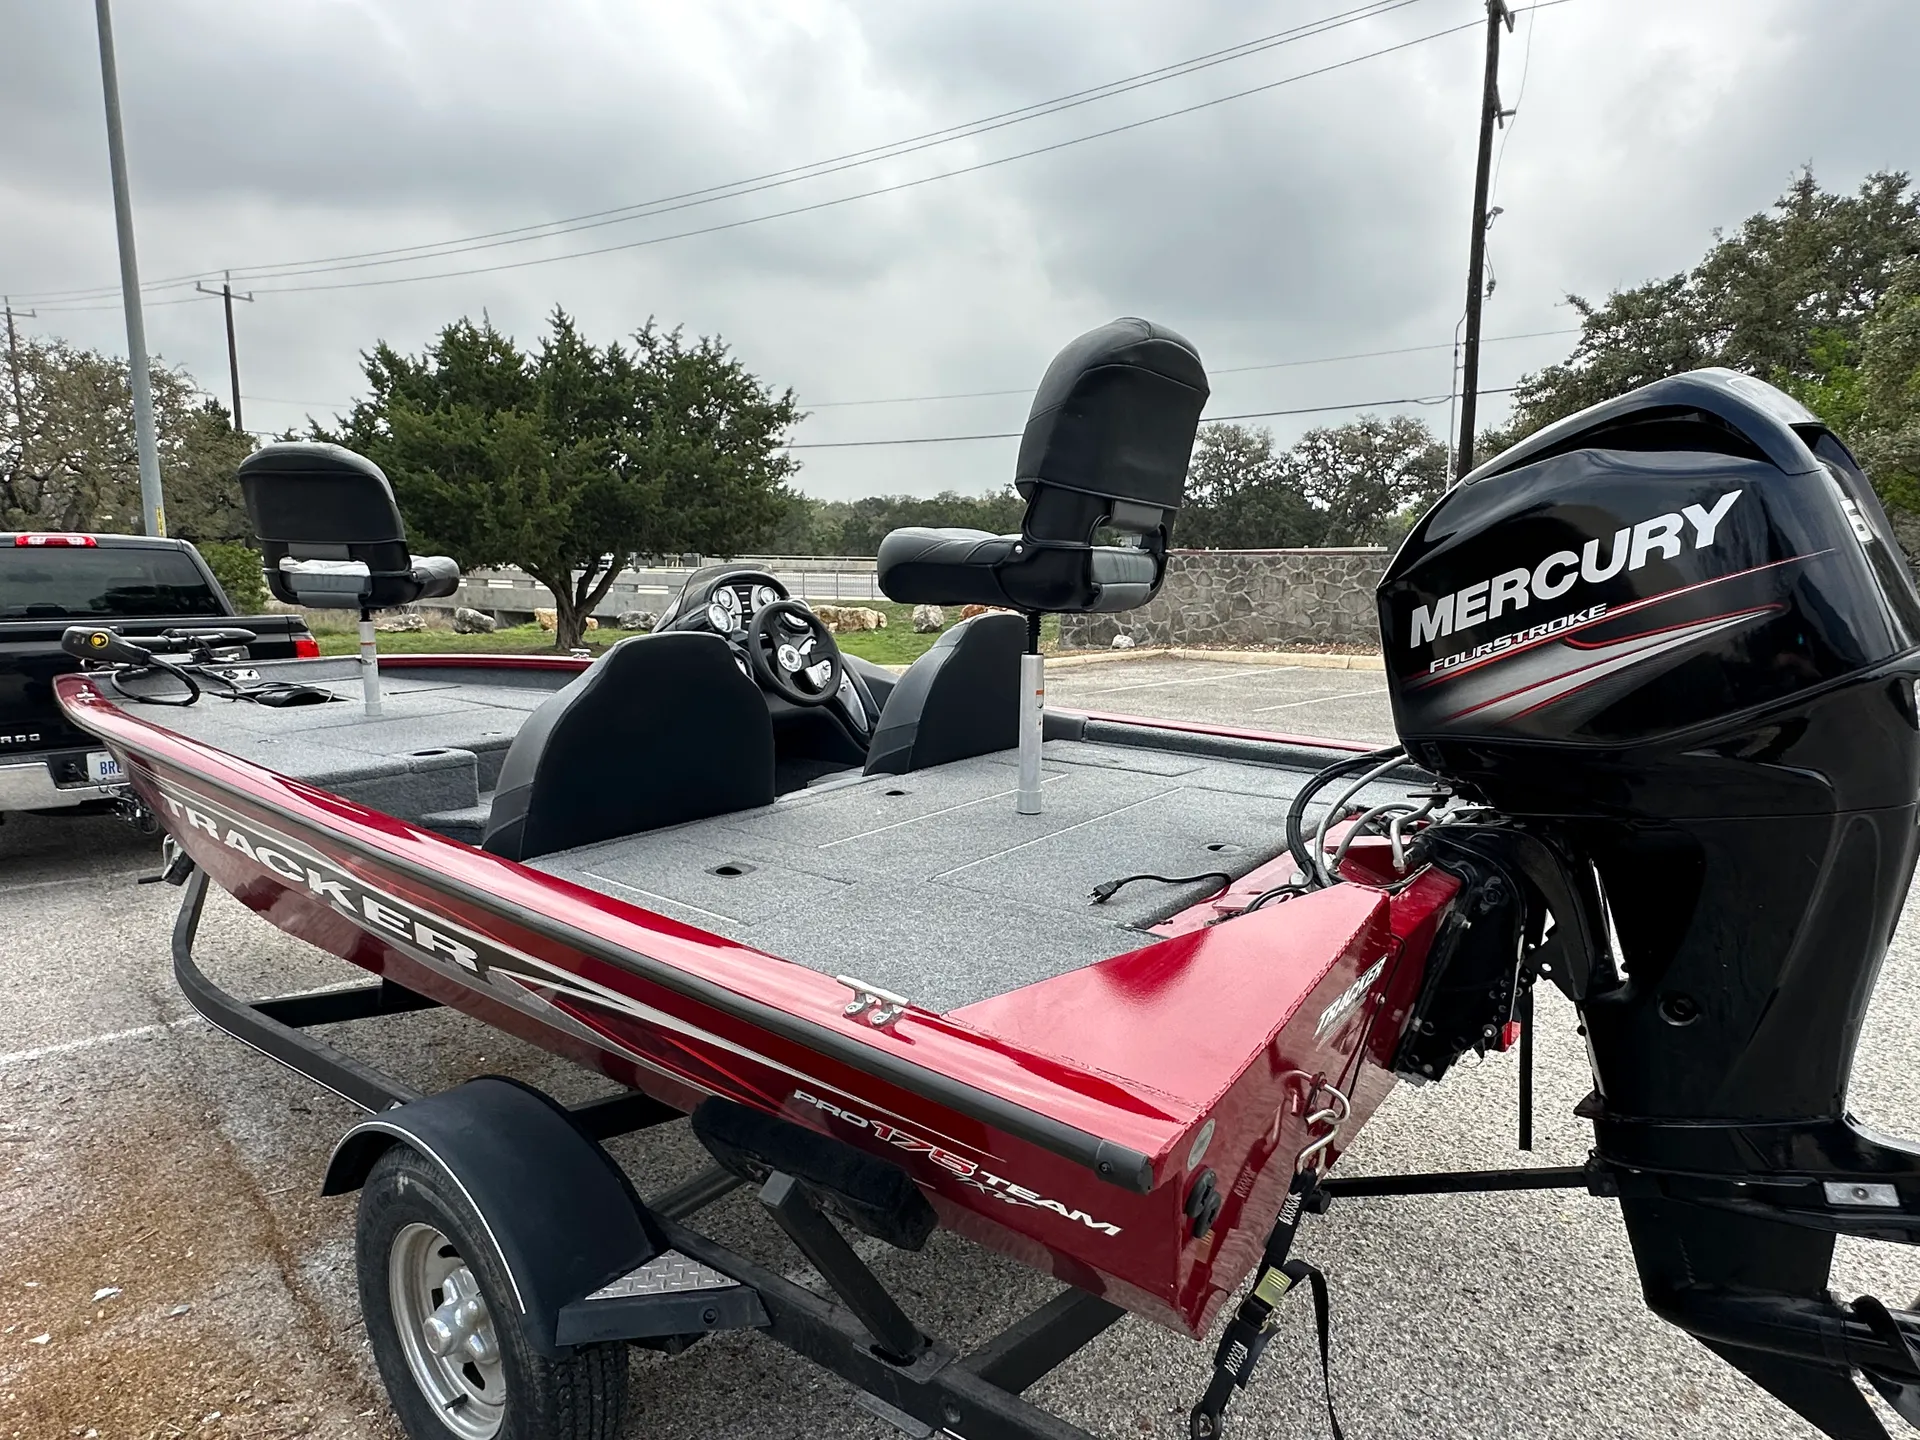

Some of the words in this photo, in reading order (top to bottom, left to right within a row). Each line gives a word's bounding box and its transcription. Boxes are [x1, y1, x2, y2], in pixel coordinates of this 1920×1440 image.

[1411, 489, 1743, 649] MERCURY
[1429, 603, 1608, 674] FOURSTROKE
[160, 792, 479, 973] TRACKER
[1312, 954, 1387, 1040] TRACKER
[793, 1089, 869, 1129] PRO
[869, 1119, 979, 1178] 175
[979, 1170, 1124, 1237] TEAM
